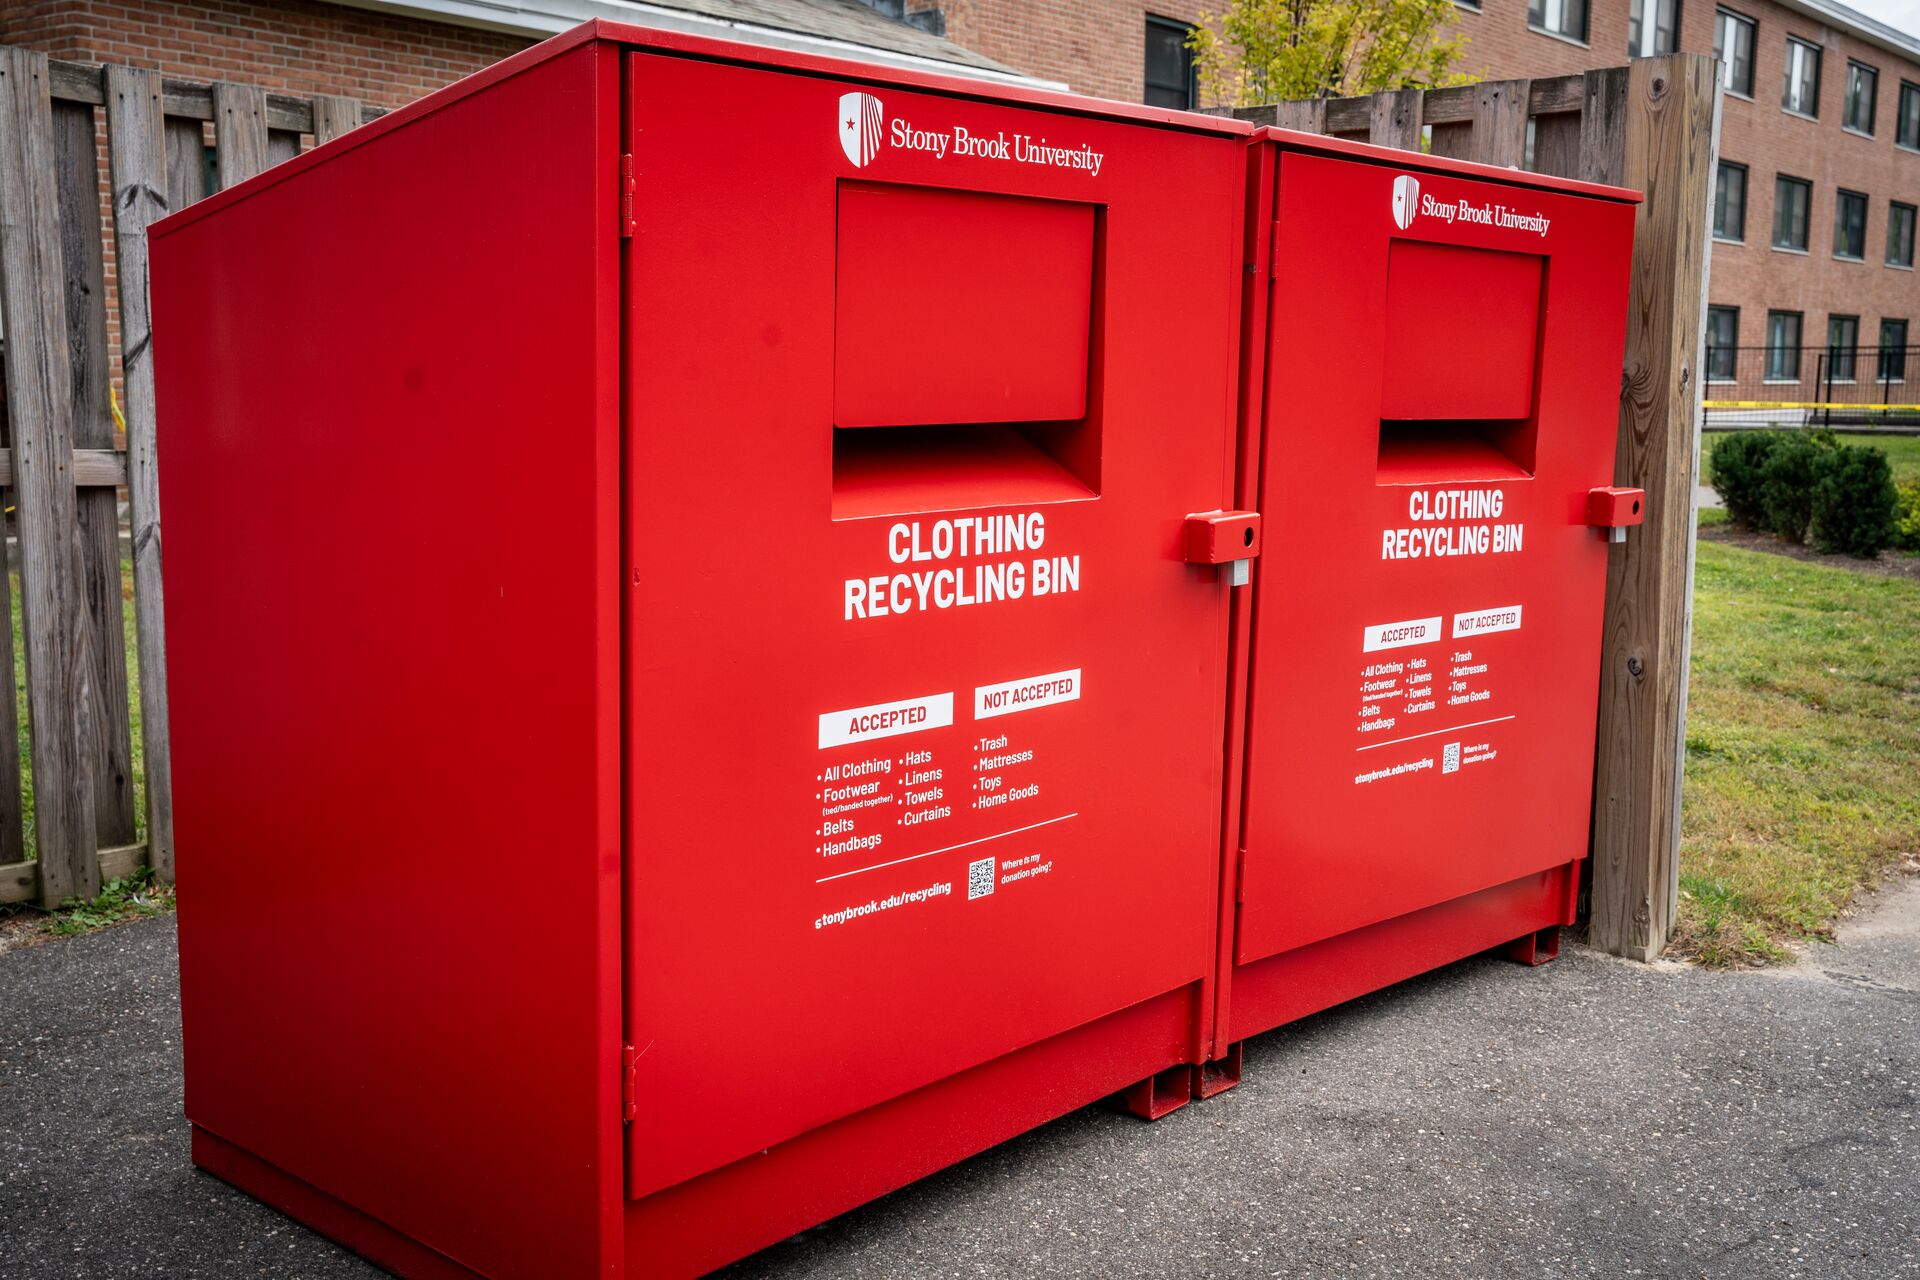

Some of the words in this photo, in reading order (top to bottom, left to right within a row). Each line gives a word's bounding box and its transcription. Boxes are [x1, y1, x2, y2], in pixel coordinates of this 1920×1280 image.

[891, 118, 950, 158] Stony
[953, 126, 1010, 160] Brook
[1013, 134, 1104, 176] University
[1422, 194, 1457, 224] Stony
[1458, 200, 1492, 225] Brook
[1494, 205, 1550, 237] University
[1410, 490, 1503, 520] CLOTHING
[888, 512, 1044, 564] CLOTHING
[1382, 525, 1490, 560] RECYCLING
[1492, 524, 1523, 553] BIN
[845, 562, 1024, 620] RECYCLING
[1032, 555, 1080, 596] BIN
[1459, 618, 1474, 631] NOT
[1476, 612, 1516, 628] ACCEPTED
[1380, 626, 1426, 644] ACCEPTED
[1410, 658, 1426, 669] Hats
[1454, 650, 1472, 662] Trash
[1365, 666, 1374, 677] All
[1375, 662, 1404, 676] Clothing
[1410, 673, 1432, 684] Linens
[1453, 664, 1488, 677] Mattresses
[984, 690, 1010, 710] NOT
[1012, 678, 1073, 704] ACCEPTED
[1364, 679, 1396, 692] Footwear
[1409, 686, 1432, 698] Towels
[1452, 681, 1466, 692] Toys
[1408, 700, 1435, 714] Curtains
[1451, 695, 1470, 706] Home
[1470, 690, 1490, 702] Goods
[849, 706, 926, 734] ACCEPTED
[1362, 705, 1380, 717] Belts
[1362, 718, 1395, 732] Handbags
[980, 734, 1008, 752] Trash
[906, 750, 932, 766] Hats
[980, 750, 1033, 772] Mattresses
[824, 766, 840, 782] All
[842, 758, 891, 778] Clothing
[905, 768, 942, 786] Linens
[1355, 758, 1434, 784] stonybrook.edu/recycling
[824, 781, 880, 803] Footwear
[979, 775, 1002, 792] Toys
[864, 794, 894, 807] together)
[905, 786, 943, 806] Towels
[978, 792, 1008, 810] Home
[1009, 784, 1039, 802] Goods
[904, 806, 951, 826] Curtains
[824, 819, 854, 836] Belts
[824, 834, 882, 857] Handbags
[1002, 857, 1024, 871] Where
[1024, 856, 1030, 864] is
[1030, 853, 1040, 864] my
[1001, 868, 1030, 884] donation
[1030, 862, 1052, 877] going?
[815, 882, 952, 929] stonybrook.edu/recycling
